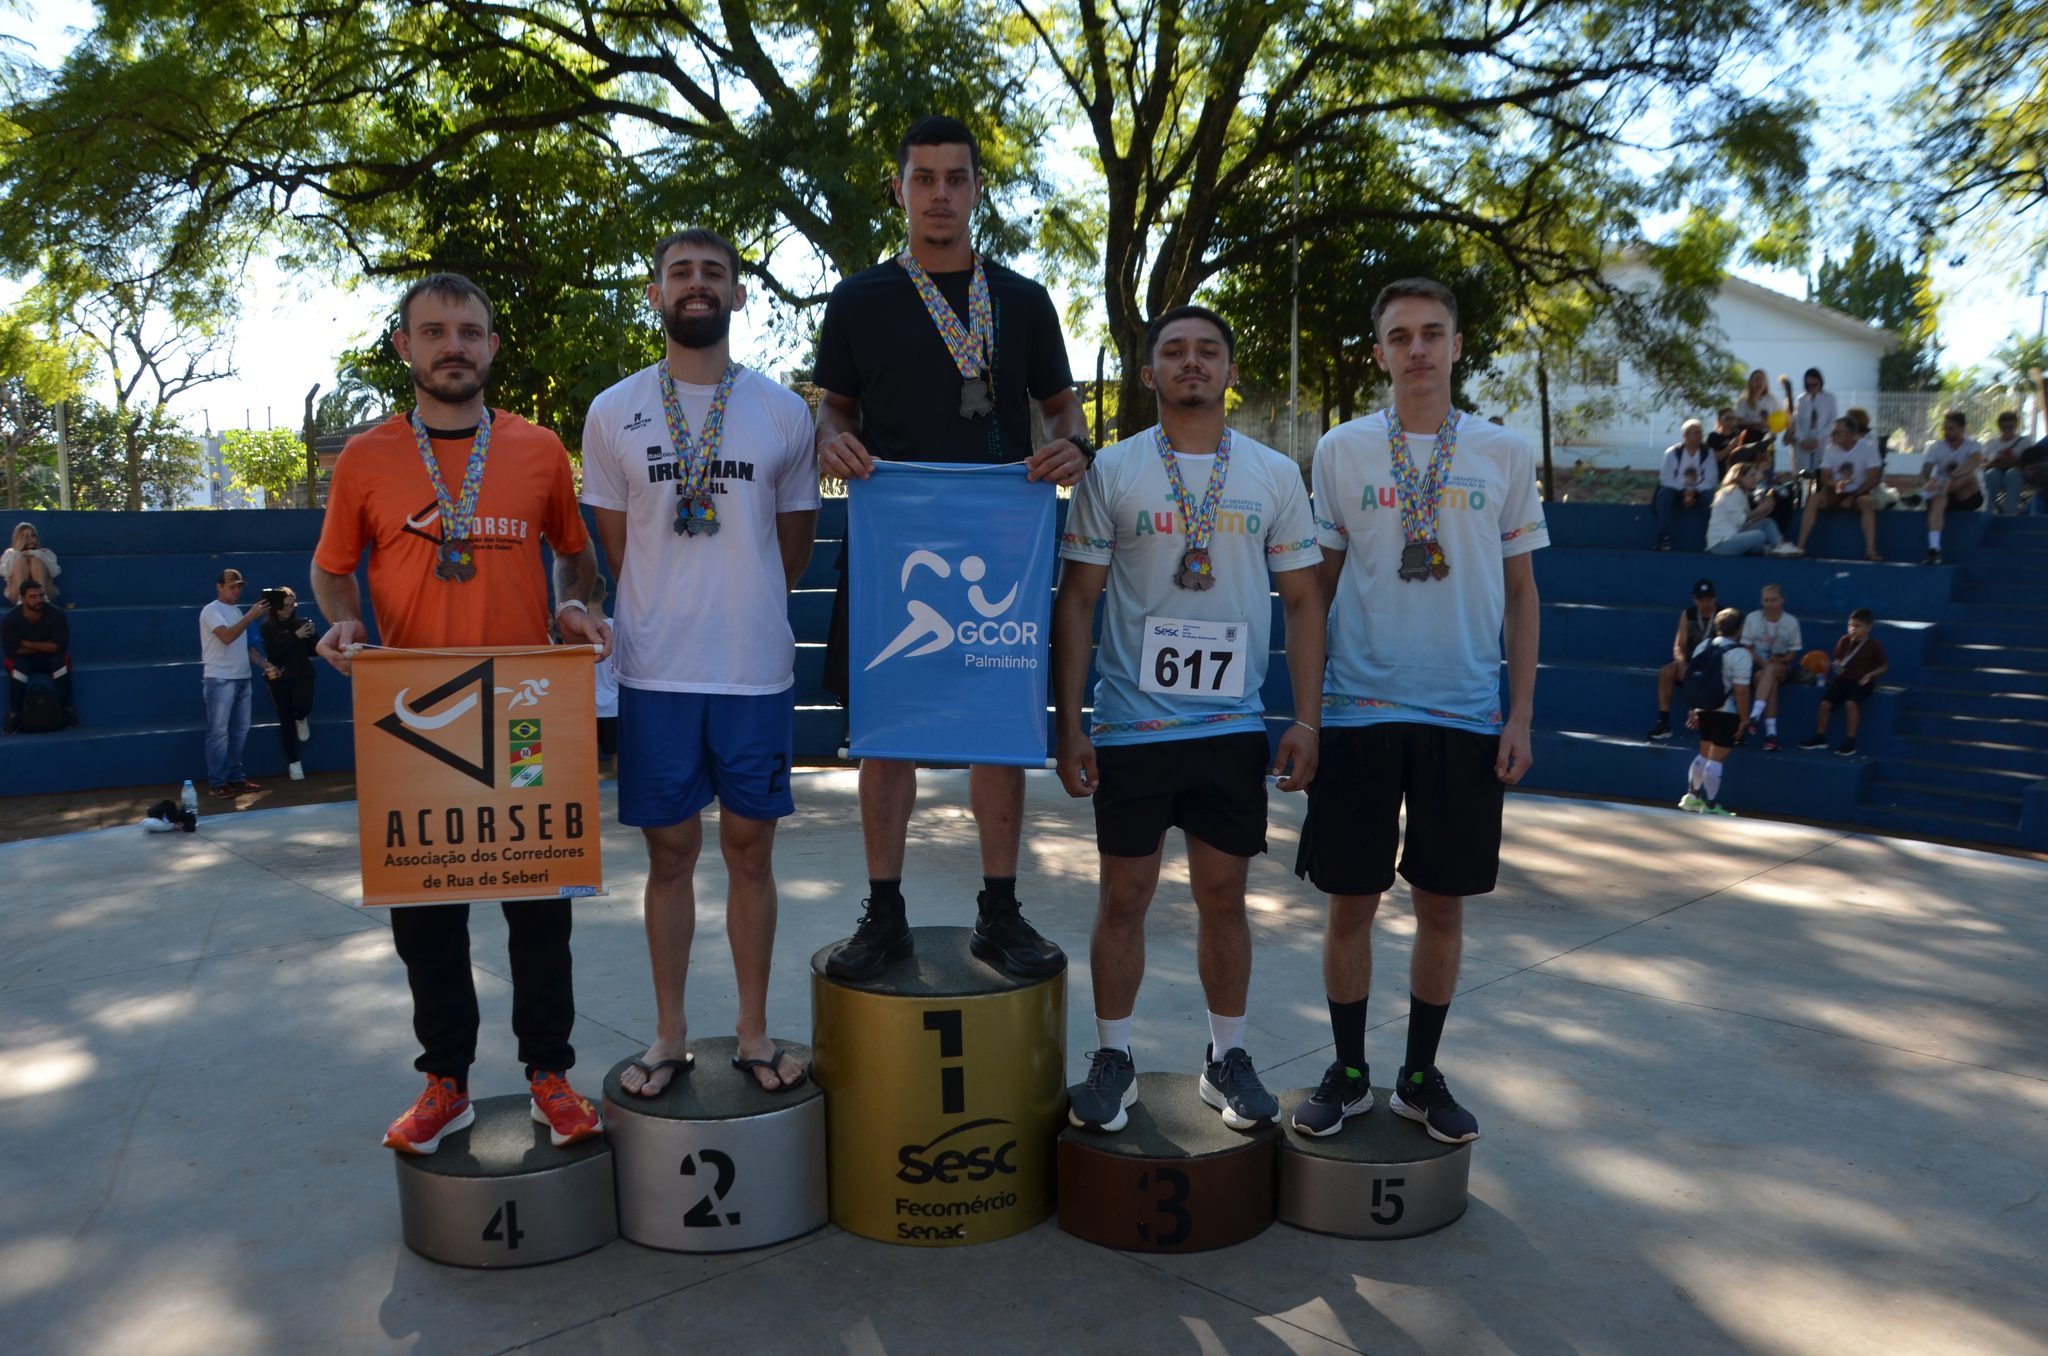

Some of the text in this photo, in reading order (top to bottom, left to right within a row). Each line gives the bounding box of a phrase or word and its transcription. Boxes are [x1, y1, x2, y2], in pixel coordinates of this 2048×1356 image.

[648, 460, 754, 483] IROMAN
[1361, 485, 1486, 511] Aumo
[472, 516, 527, 538] ORSEB
[957, 620, 1038, 645] GCOR
[965, 654, 1038, 669] Palmitinho
[1155, 646, 1233, 690] 617
[386, 802, 584, 848] ACORSEB
[384, 845, 585, 868] Associação dos Corredores
[422, 869, 549, 889] de Rua de Seberi
[923, 1009, 965, 1114] 1
[680, 1149, 741, 1228] 2
[895, 1190, 1017, 1217] Fecomércio
[1137, 1167, 1193, 1247] 3
[1370, 1178, 1405, 1226] 5
[482, 1201, 524, 1250] 4
[897, 1222, 967, 1240] Senac
